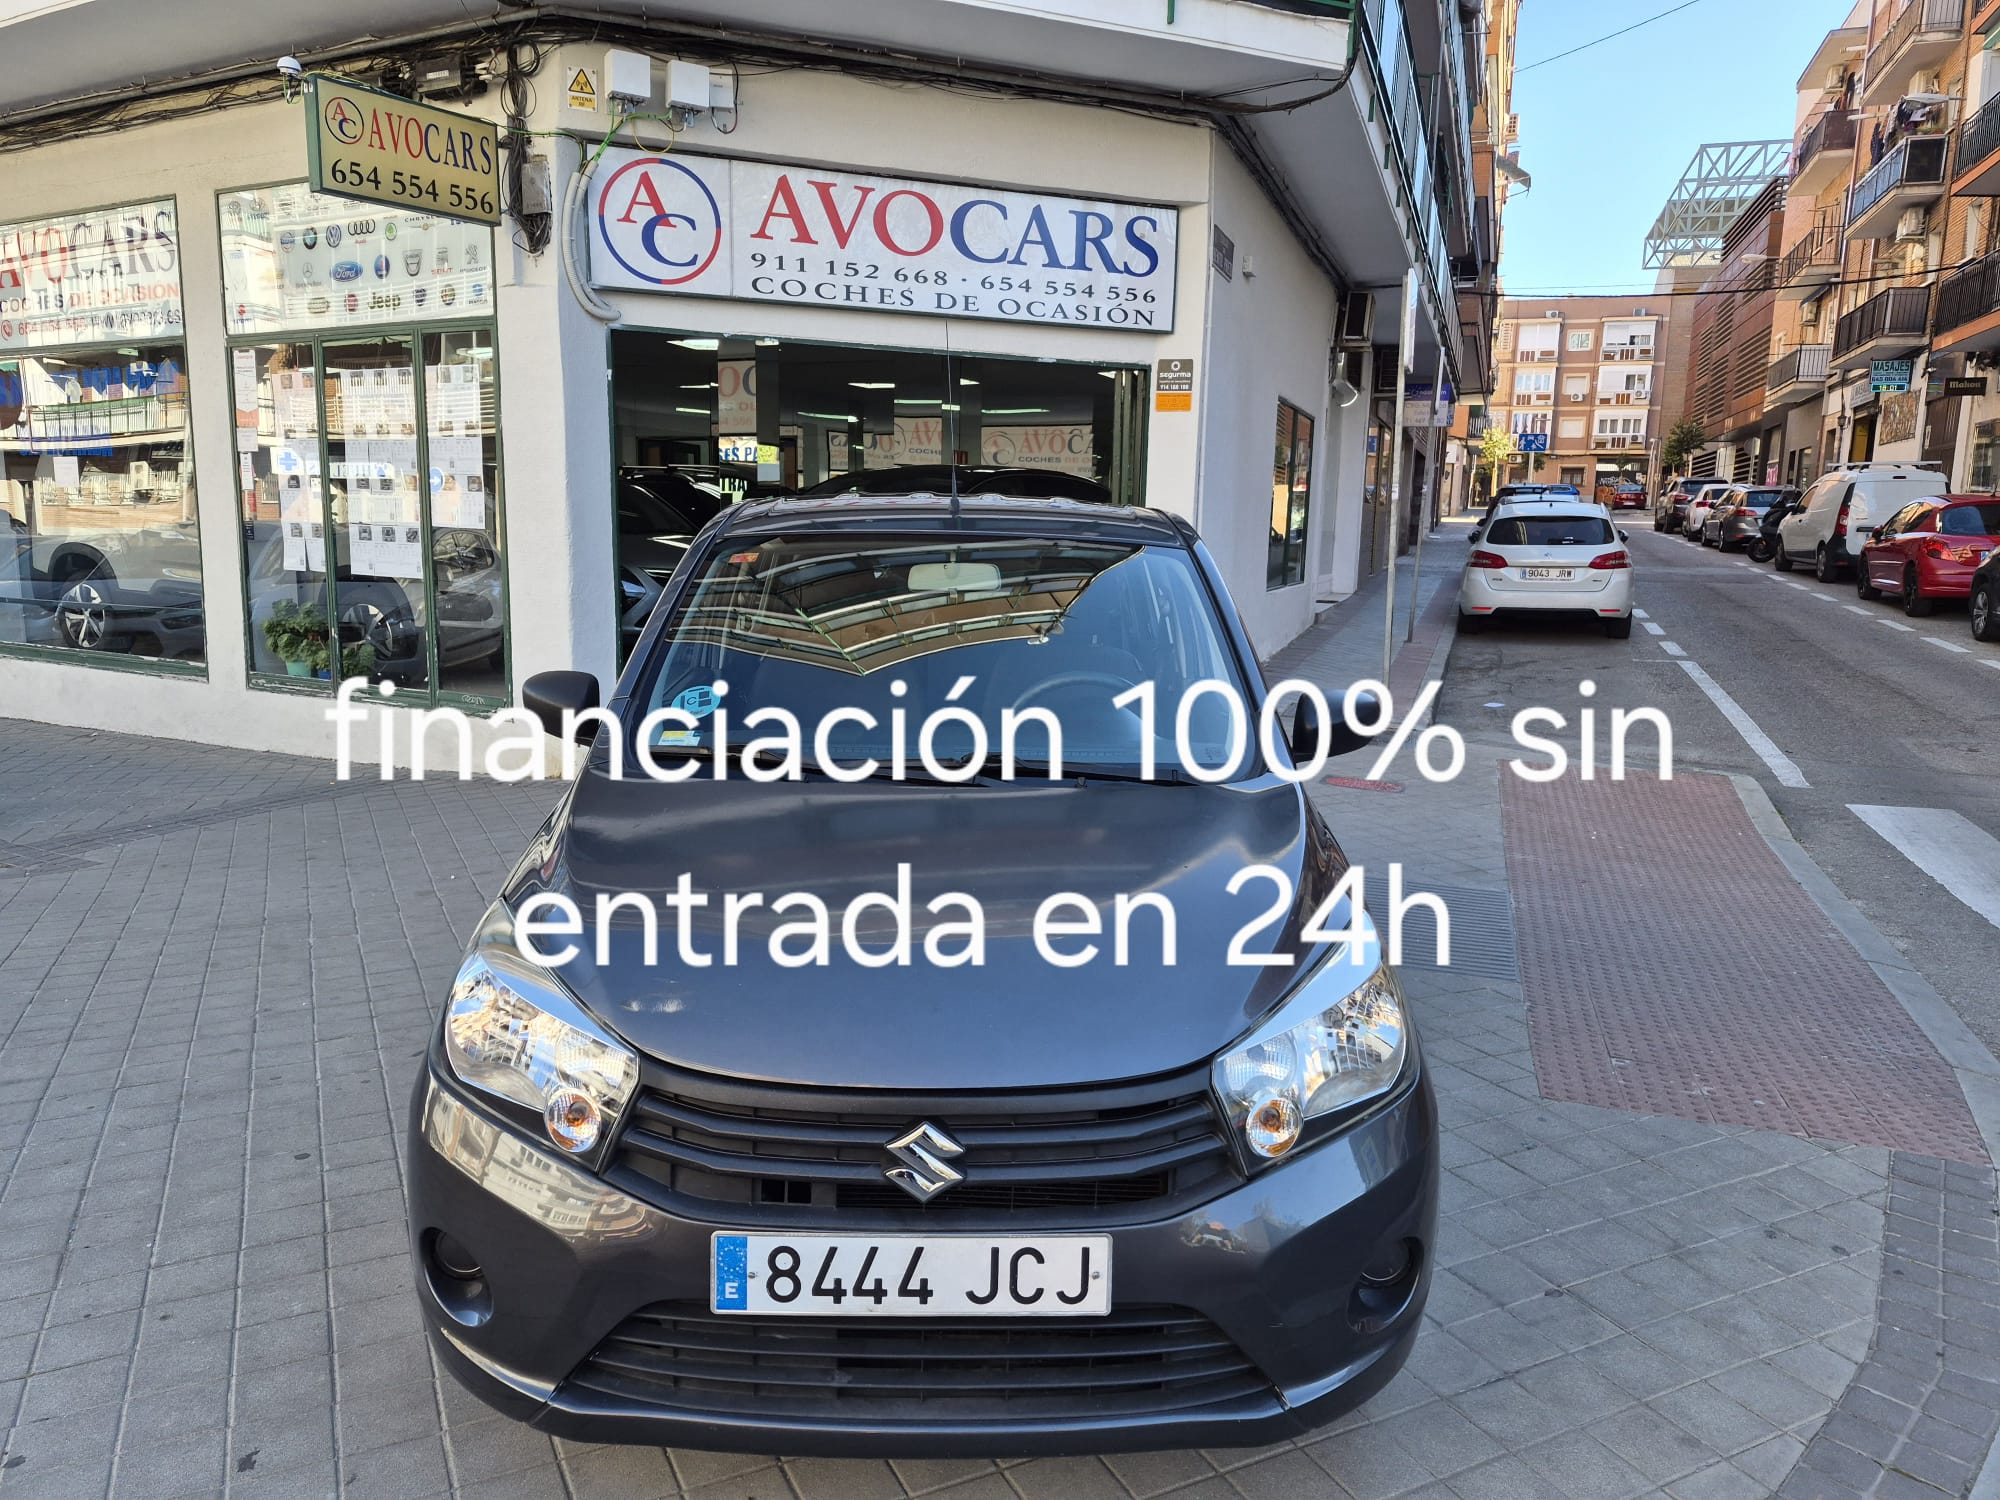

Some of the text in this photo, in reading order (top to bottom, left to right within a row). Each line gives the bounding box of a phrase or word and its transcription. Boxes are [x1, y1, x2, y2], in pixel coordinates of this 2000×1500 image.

[368, 107, 492, 175] AVOCARS
[331, 158, 494, 214] 654 554 556
[750, 173, 1159, 278] AVOCARS
[750, 252, 1156, 304] 911 152 668 654 554 556
[751, 276, 1156, 327] COCHES DE OCASIÓN
[1873, 361, 1910, 371] MASAJES
[1528, 569, 1572, 578] 9043 JRW
[725, 1245, 1090, 1305] E 8444 JCJ
